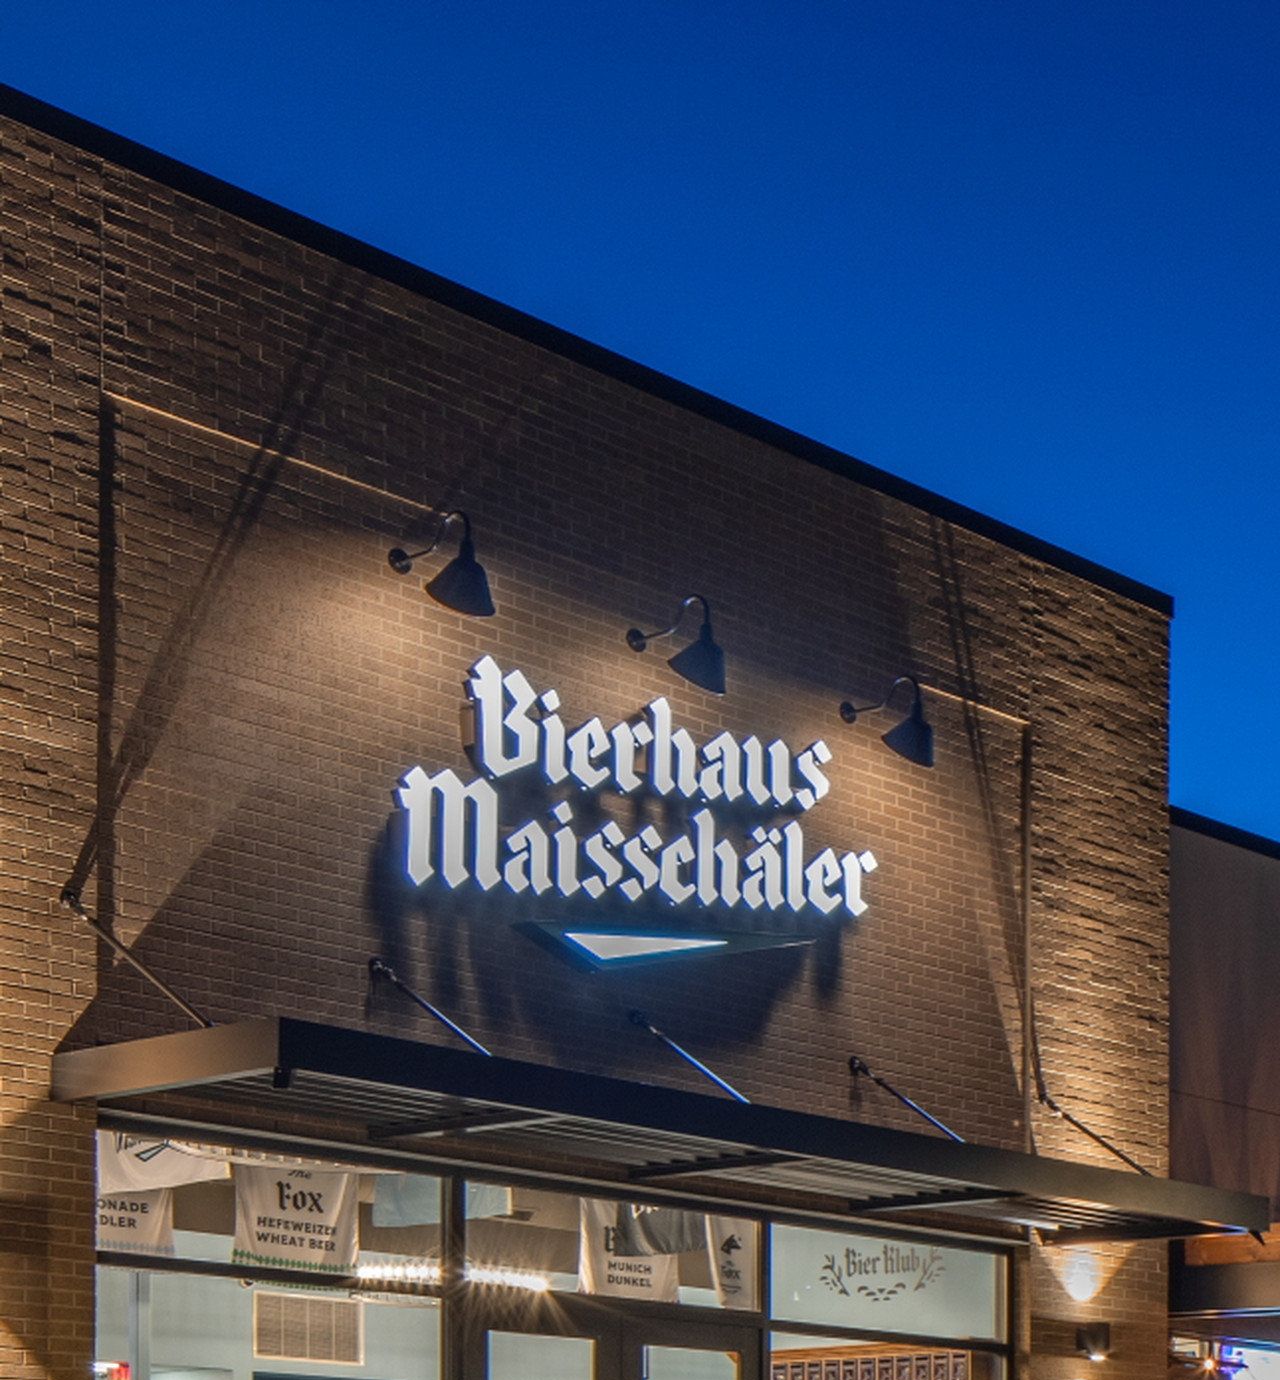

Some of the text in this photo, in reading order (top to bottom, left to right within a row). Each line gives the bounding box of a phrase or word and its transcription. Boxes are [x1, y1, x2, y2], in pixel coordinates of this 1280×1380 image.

[467, 654, 833, 812] Bierhaus
[397, 765, 879, 918] Maisschäler
[276, 1180, 324, 1215] Fox
[255, 1231, 306, 1248] WHEAT
[607, 1260, 653, 1275] MUNICH
[845, 1244, 921, 1278] Bier Klub
[607, 1273, 653, 1288] DUNKEL
